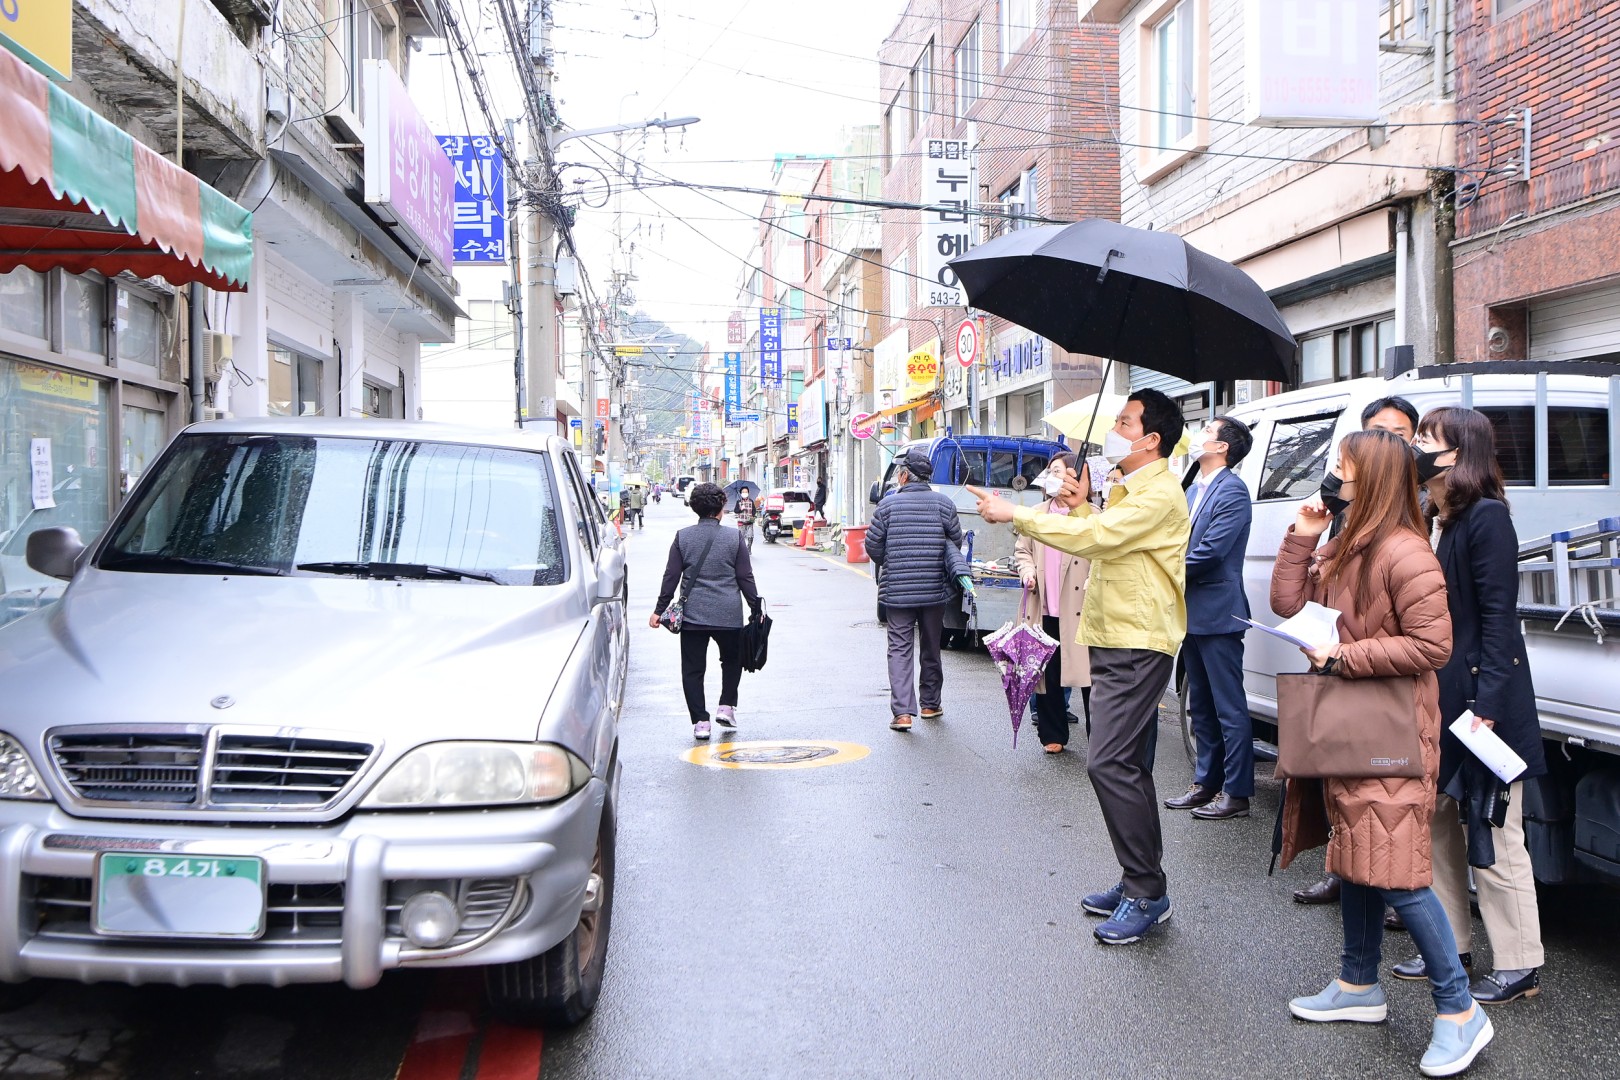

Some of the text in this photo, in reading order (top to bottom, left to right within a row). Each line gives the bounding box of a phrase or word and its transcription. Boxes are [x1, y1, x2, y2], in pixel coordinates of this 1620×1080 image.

[441, 136, 497, 157] 삼양
[393, 110, 452, 244] 삼양세탁소
[454, 159, 498, 238] 세탁
[453, 239, 504, 261] 수선
[961, 333, 973, 354] 30
[907, 363, 937, 375] 옷수선
[143, 859, 221, 879] 84가
